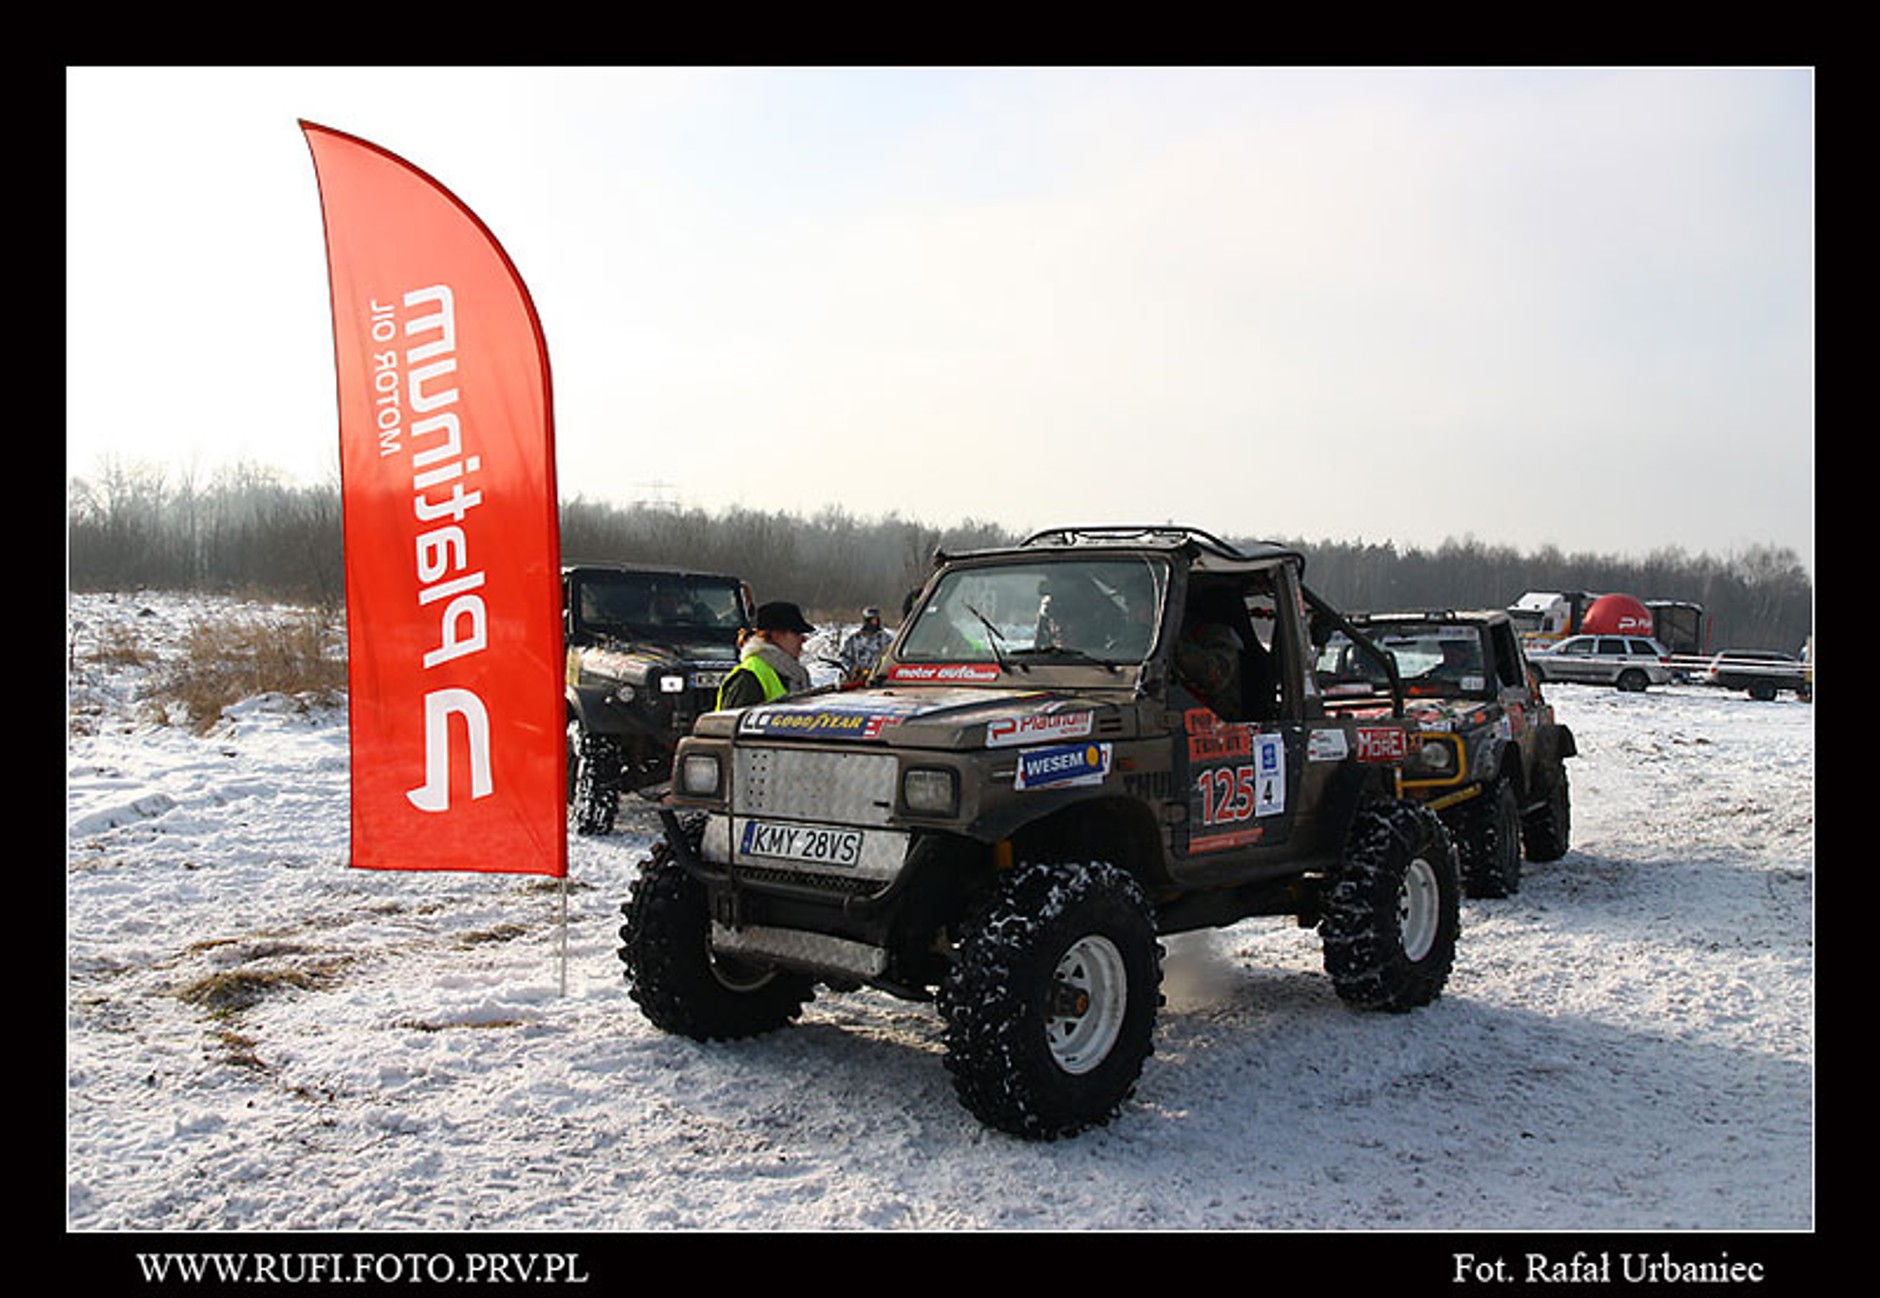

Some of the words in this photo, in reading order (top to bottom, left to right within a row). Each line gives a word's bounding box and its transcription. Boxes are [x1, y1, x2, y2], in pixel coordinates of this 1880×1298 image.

[771, 712, 864, 732] GOODYEAR
[1026, 751, 1085, 777] WESEM
[1198, 766, 1255, 826] 125
[1263, 780, 1274, 805] 4
[754, 825, 800, 855] KMY
[801, 830, 857, 862] 28VS
